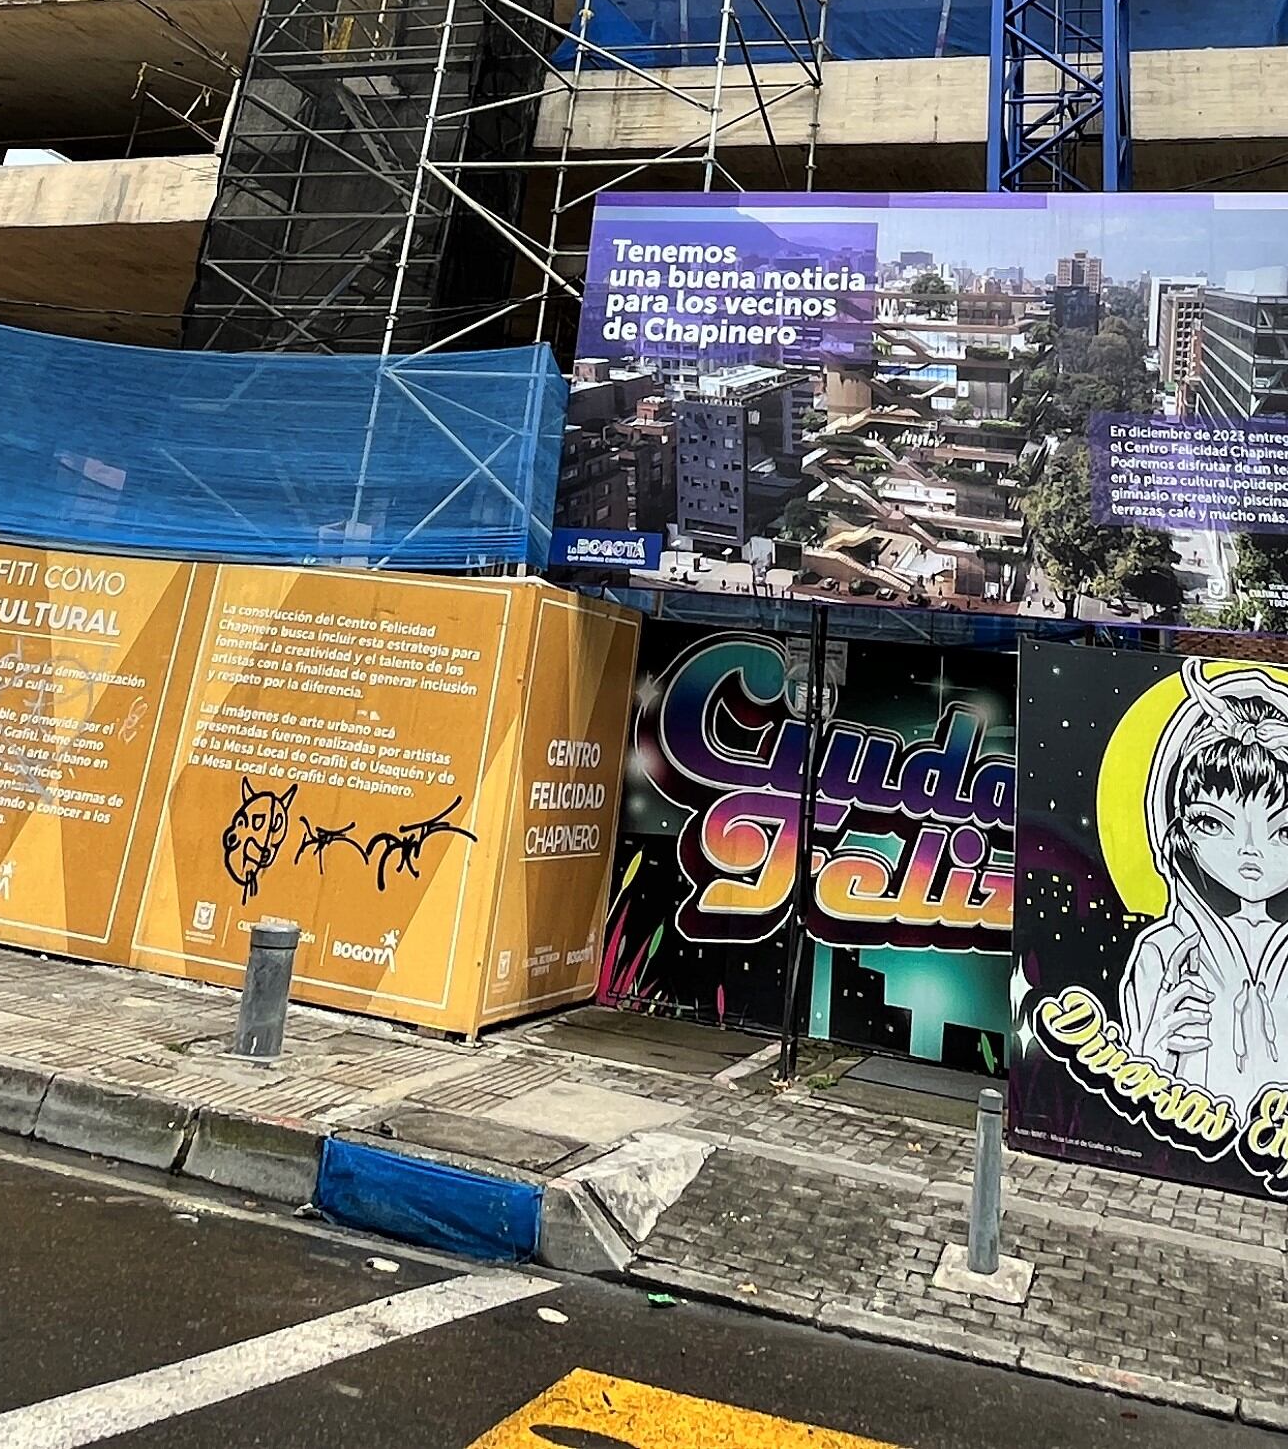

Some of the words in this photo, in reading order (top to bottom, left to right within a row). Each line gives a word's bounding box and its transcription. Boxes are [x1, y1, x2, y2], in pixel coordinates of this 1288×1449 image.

[613, 239, 737, 264] Tenemos
[609, 268, 661, 288] una
[668, 264, 757, 290] buena
[763, 267, 866, 291] noticia
[606, 292, 668, 317] para
[675, 290, 717, 314] los
[724, 292, 837, 317] vecinos
[602, 317, 638, 340] de
[644, 317, 798, 349] Chapinero
[1110, 425, 1126, 437] En
[1128, 426, 1191, 440] diciembre
[1194, 429, 1210, 440] de
[1213, 430, 1245, 442] 2023
[1110, 442, 1121, 452] el
[1124, 441, 1168, 454] Centro
[1171, 443, 1227, 457] Felicidad
[1110, 456, 1174, 469] Podremos
[1177, 459, 1232, 472] disfrutar
[1234, 462, 1251, 473] de
[1252, 464, 1271, 475] un
[1110, 474, 1127, 484] en
[1129, 472, 1141, 484] la
[1144, 473, 1177, 487] plaza
[1111, 487, 1169, 502] gimnasio
[1172, 491, 1240, 506] recreativo,
[1112, 503, 1166, 518] terrazas,
[1168, 506, 1196, 518] café
[1199, 510, 1207, 521] y
[1210, 509, 1256, 522] mucho
[577, 537, 645, 558] BOGOTÁ
[44, 565, 126, 596] COMO
[223, 602, 236, 615] La
[238, 605, 312, 623] construcción
[315, 612, 334, 626] del
[336, 615, 377, 631] Centro
[380, 620, 437, 637] Felicidad
[218, 618, 278, 636] Chapinero
[280, 626, 315, 641] busca
[318, 630, 357, 645] incluir
[358, 637, 385, 648] esta
[387, 640, 449, 658] estrategia
[451, 648, 481, 661] para
[215, 635, 269, 652] fomentar
[285, 645, 352, 662] creatividad
[379, 655, 424, 671] talento
[445, 662, 464, 676] los
[212, 652, 255, 667] artistas
[295, 661, 348, 679] finalidad
[369, 672, 417, 688] generar
[420, 676, 477, 695] inclusión
[217, 670, 262, 685] respeto
[300, 679, 364, 699] diferencia.
[222, 703, 279, 723] imágenes
[299, 716, 325, 729] arte
[327, 720, 371, 735] urbano
[196, 720, 269, 739] presentadas
[271, 728, 311, 745] fueron
[313, 736, 376, 754] realizadas
[402, 748, 452, 765] artistas
[547, 738, 601, 768] CENTRO
[223, 740, 255, 754] Mesa
[256, 744, 289, 760] Local
[309, 752, 348, 769] Grafiti
[369, 760, 425, 780] Usaquén
[201, 753, 232, 769] Mesa
[235, 759, 267, 775] Local
[287, 767, 326, 784] Grafiti
[346, 776, 415, 798] Chapinero.
[529, 781, 605, 810] FELICIDAD
[37, 803, 82, 819] conocer
[525, 824, 600, 854] CHAPINERO
[1040, 990, 1237, 1141] Diversas
